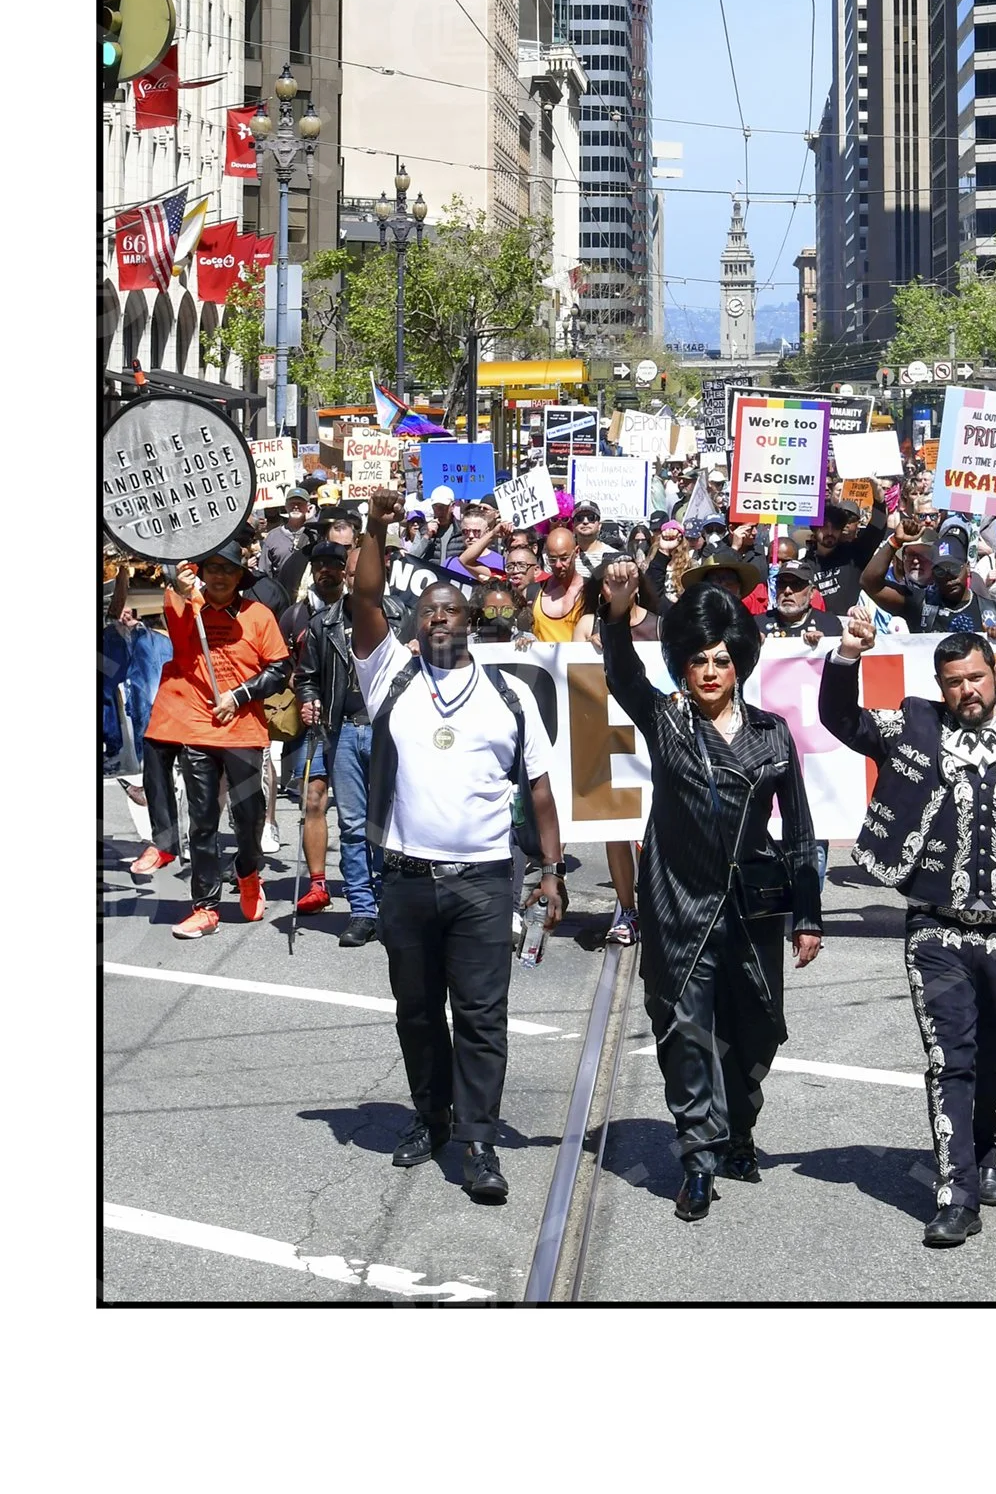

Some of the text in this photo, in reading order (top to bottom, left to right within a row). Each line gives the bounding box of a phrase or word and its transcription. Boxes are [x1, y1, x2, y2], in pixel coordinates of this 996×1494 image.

[122, 254, 147, 266] MARK
[830, 407, 863, 418] UMANITY
[972, 411, 983, 421] ALL
[984, 413, 996, 423] OUT
[625, 415, 671, 433] DEPORT
[748, 416, 818, 430] We're too
[117, 426, 212, 468] FREE
[629, 435, 669, 453] ELON
[755, 435, 808, 448] QUEER
[346, 440, 398, 459] Republic
[770, 454, 792, 466] for
[974, 457, 991, 468] TIME
[103, 446, 235, 495] ANDRY JOSE
[358, 470, 383, 480] TIME
[743, 472, 815, 486] FASCISM!
[114, 469, 242, 517] RNANDEZ
[494, 475, 529, 499] TRUMP
[254, 490, 273, 502] VIL
[510, 486, 538, 511] FUCK
[742, 498, 797, 512] castro
[136, 496, 238, 537] OMERO
[512, 501, 546, 527] OFF!
